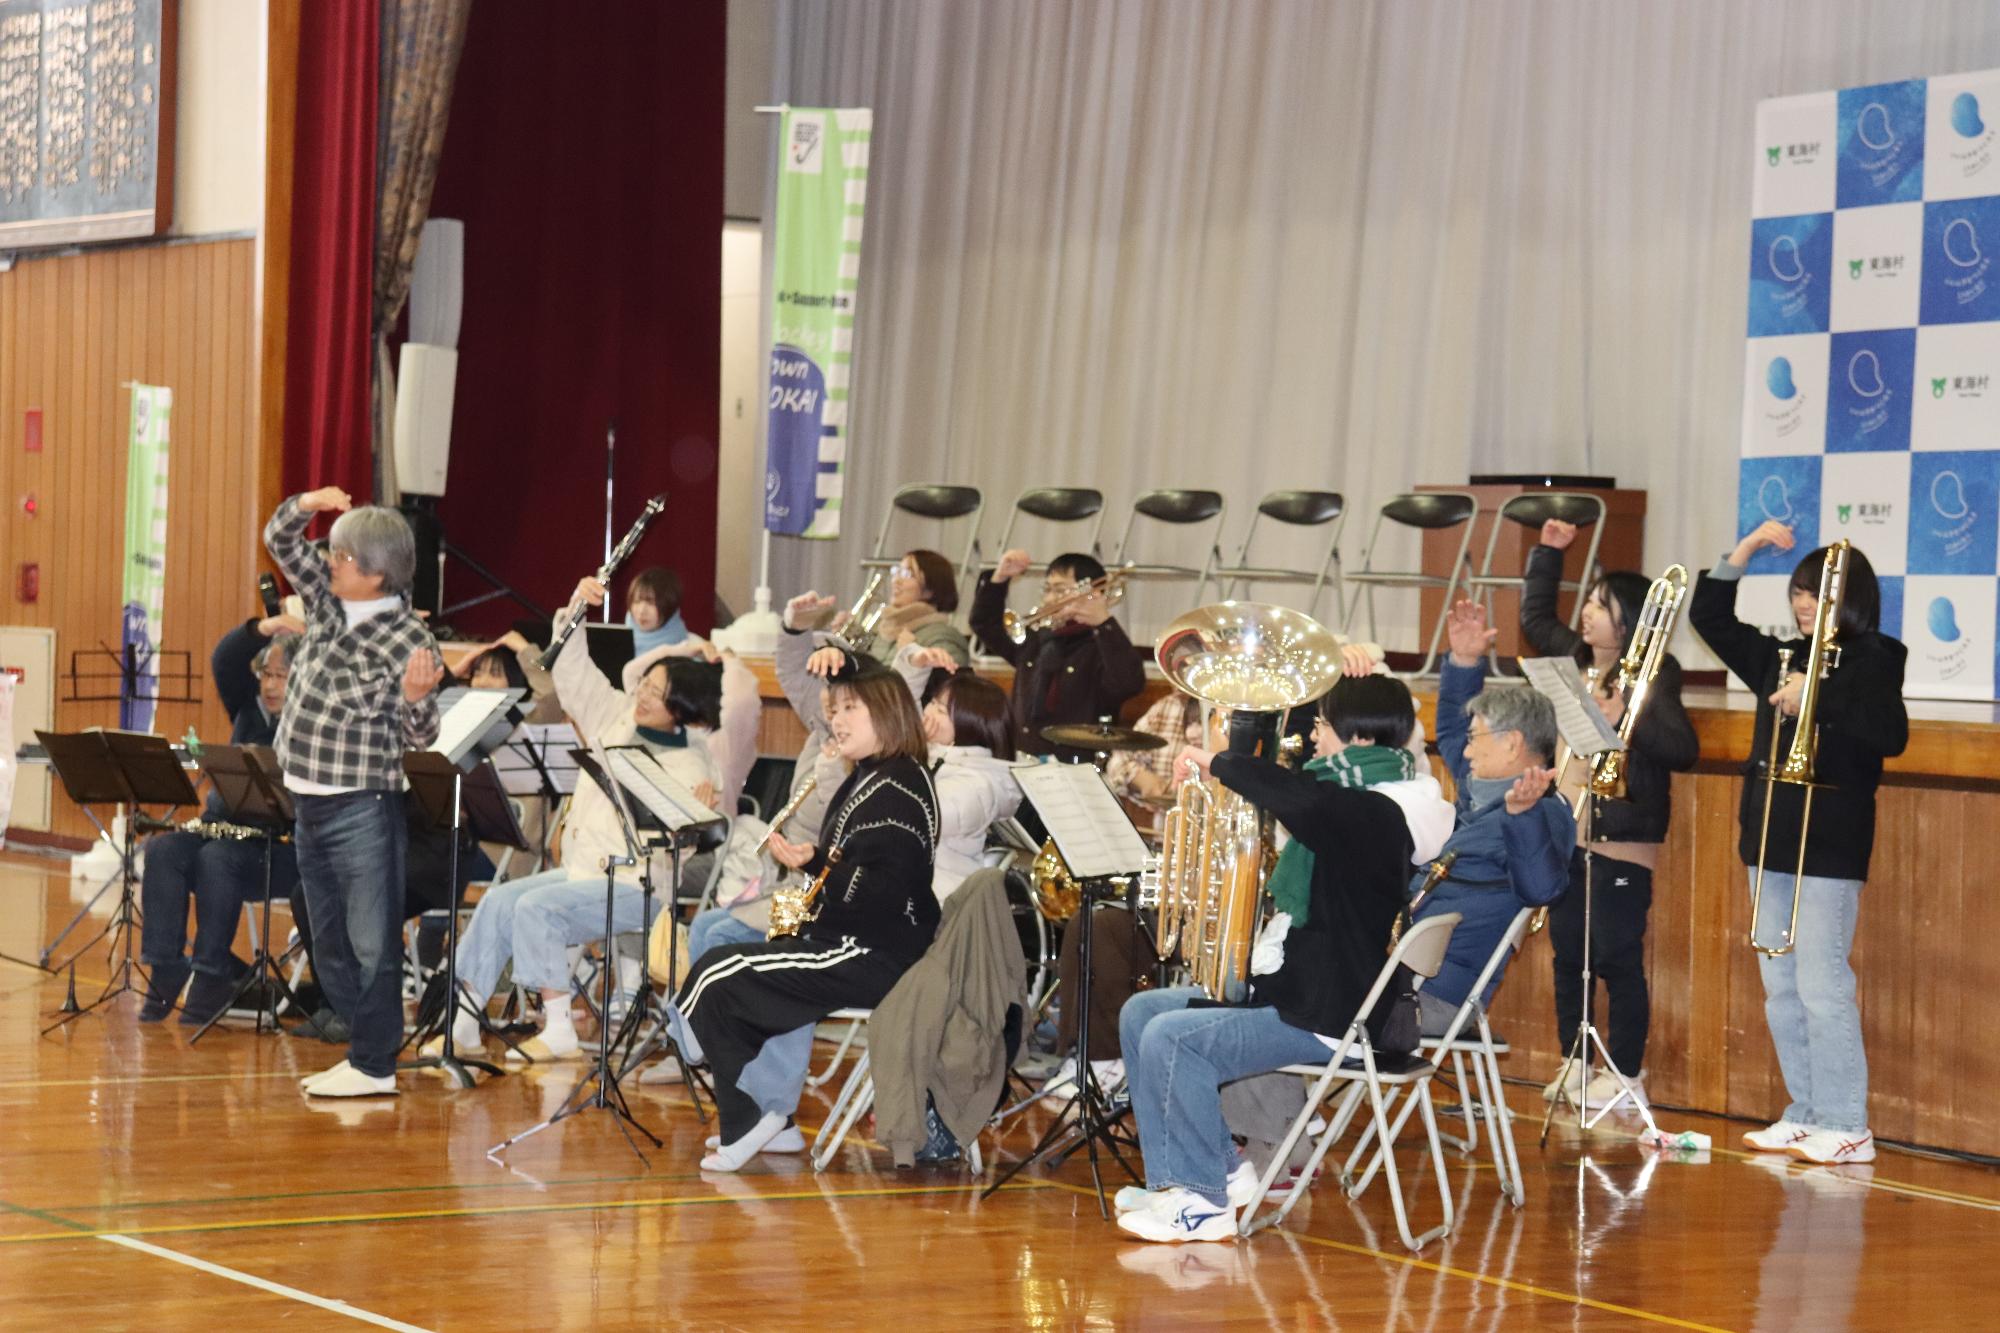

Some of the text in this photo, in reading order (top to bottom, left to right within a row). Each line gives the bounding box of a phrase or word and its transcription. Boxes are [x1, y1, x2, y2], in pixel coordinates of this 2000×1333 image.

[1869, 255, 1904, 270] 東海村
[1953, 375, 1989, 390] 東海村
[1858, 503, 1892, 518] 東海村
